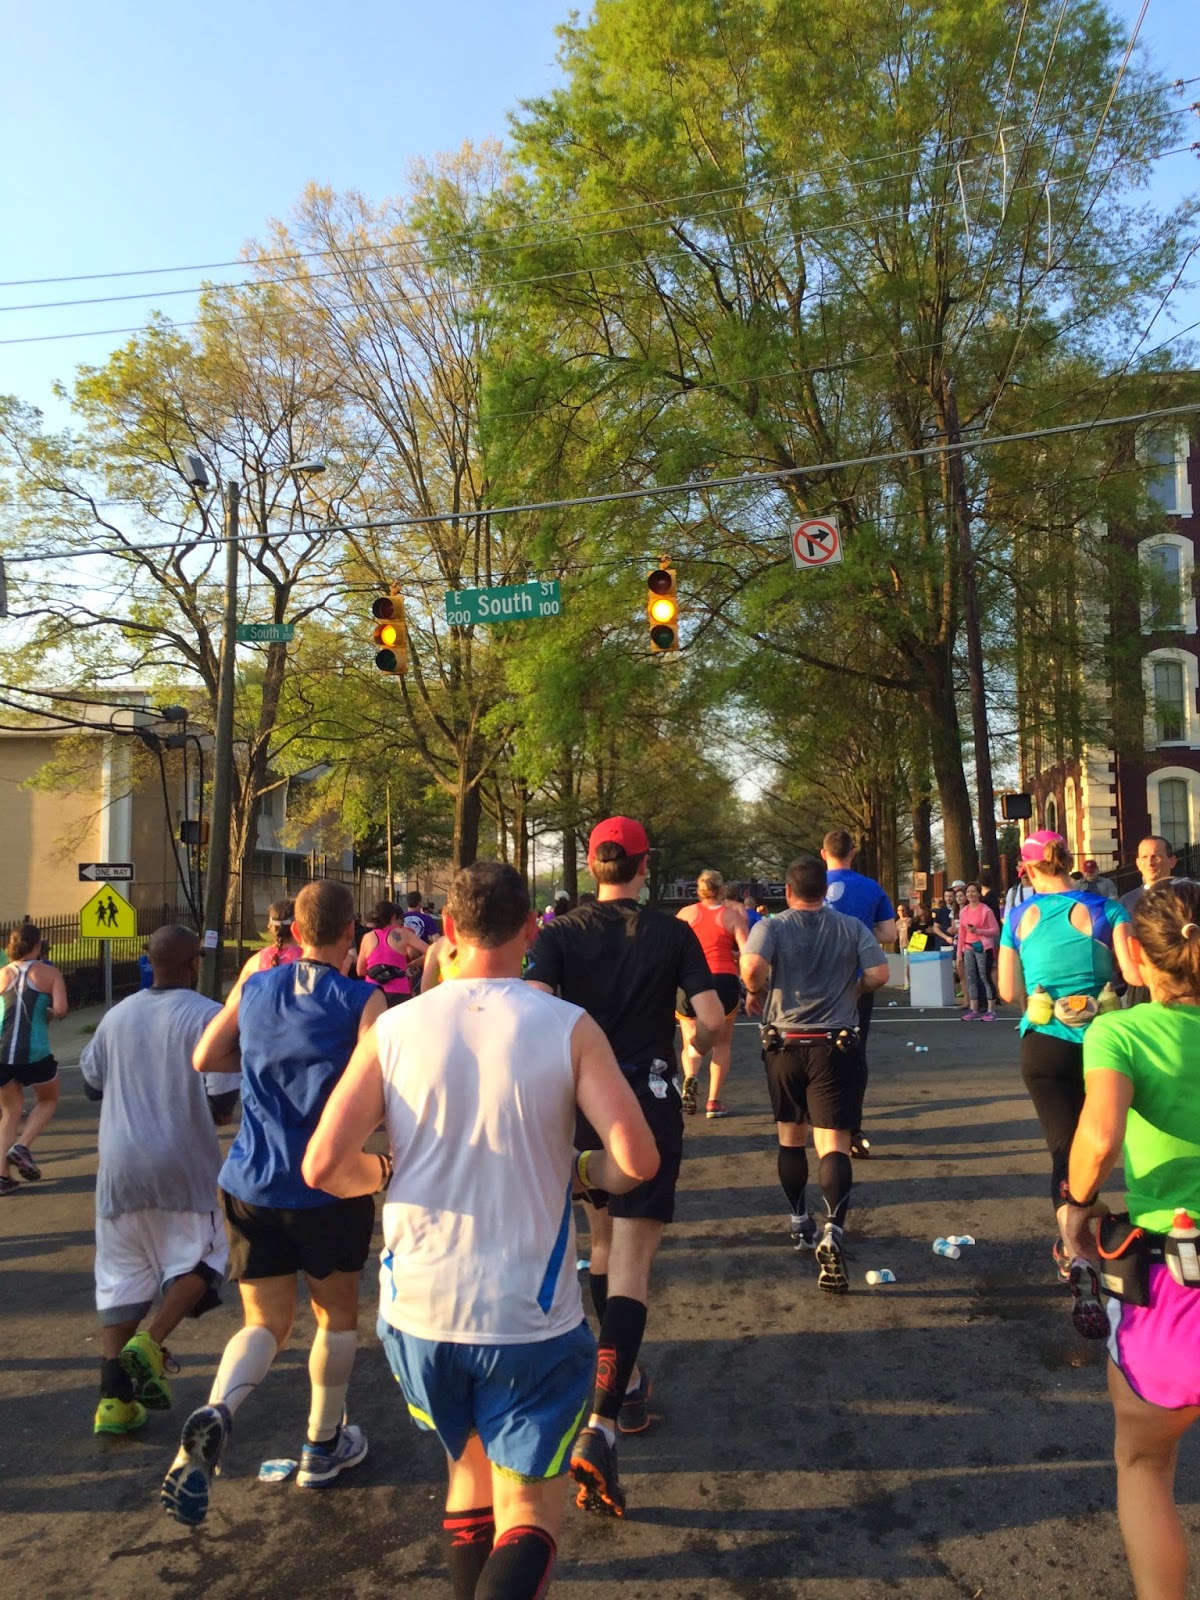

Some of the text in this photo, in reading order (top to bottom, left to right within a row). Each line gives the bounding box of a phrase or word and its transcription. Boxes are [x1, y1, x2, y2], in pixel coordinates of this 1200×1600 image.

[454, 582, 555, 616] E South ST
[448, 601, 559, 625] 200 100
[250, 626, 280, 639] South
[95, 868, 128, 876] ONE WAY
